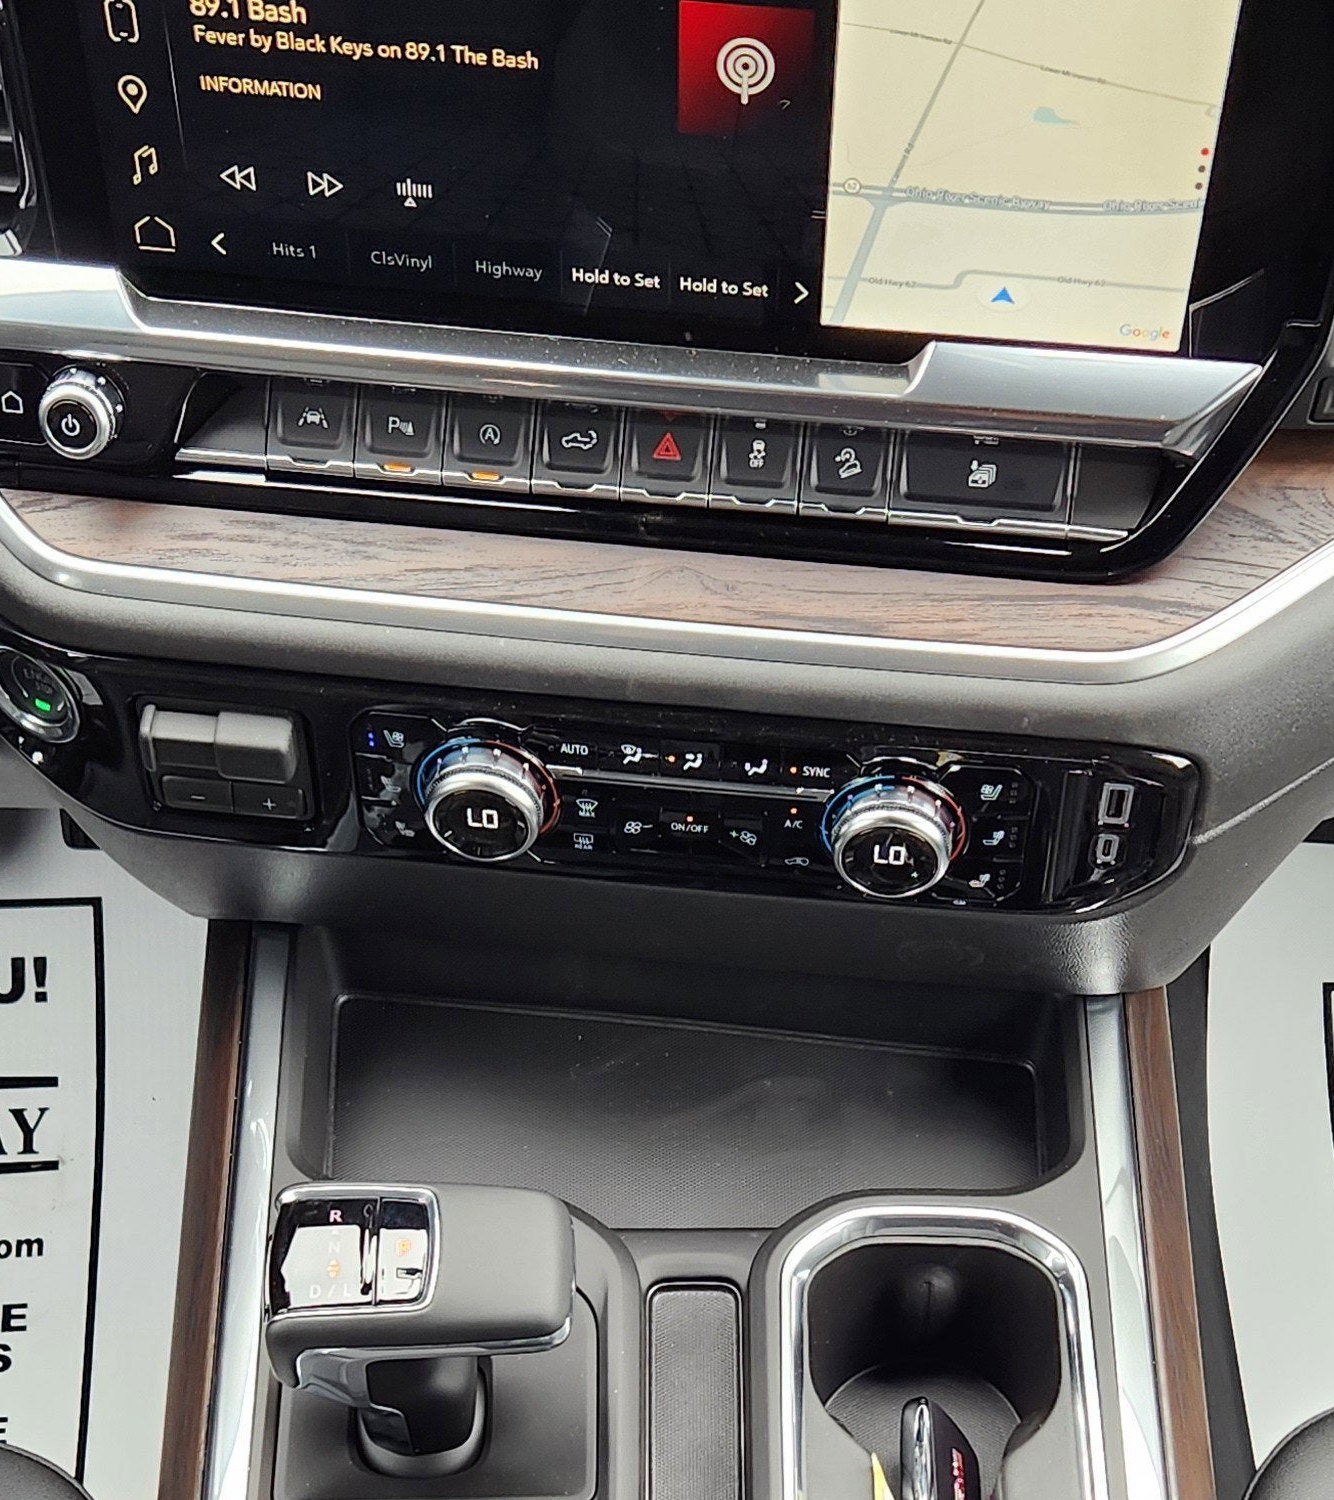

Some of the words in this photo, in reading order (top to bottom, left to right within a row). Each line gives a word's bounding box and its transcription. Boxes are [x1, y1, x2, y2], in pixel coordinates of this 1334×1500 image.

[189, 0, 240, 19] 89.1
[247, 0, 307, 25] Bash
[192, 25, 245, 46] Fever
[249, 28, 272, 53] by
[275, 31, 327, 53] Black
[329, 35, 374, 60] Keys
[377, 44, 401, 59] on
[404, 41, 446, 63] 89.1
[450, 44, 488, 66] The
[491, 48, 539, 70] Bash
[199, 74, 322, 100] INFORMATION
[906, 186, 932, 198] Ohio
[936, 188, 966, 202] River
[272, 241, 305, 258] Hits
[308, 245, 316, 259] 1
[370, 251, 433, 272] ClsVinyl
[475, 260, 543, 282] Highway
[571, 267, 610, 285] Hold
[613, 272, 631, 287] to
[634, 273, 661, 290] Set
[680, 277, 717, 294] Hold
[721, 280, 739, 295] to
[742, 282, 769, 298] Set
[868, 277, 883, 286] Old
[884, 279, 904, 290] Hwy
[1119, 323, 1171, 341] Google
[560, 743, 589, 756] AUTO
[801, 766, 831, 778] SYNC
[467, 807, 499, 829] LO
[784, 819, 803, 830] A/C
[670, 822, 710, 834] ON/OFF
[873, 844, 906, 865] LO
[329, 1209, 343, 1223] R
